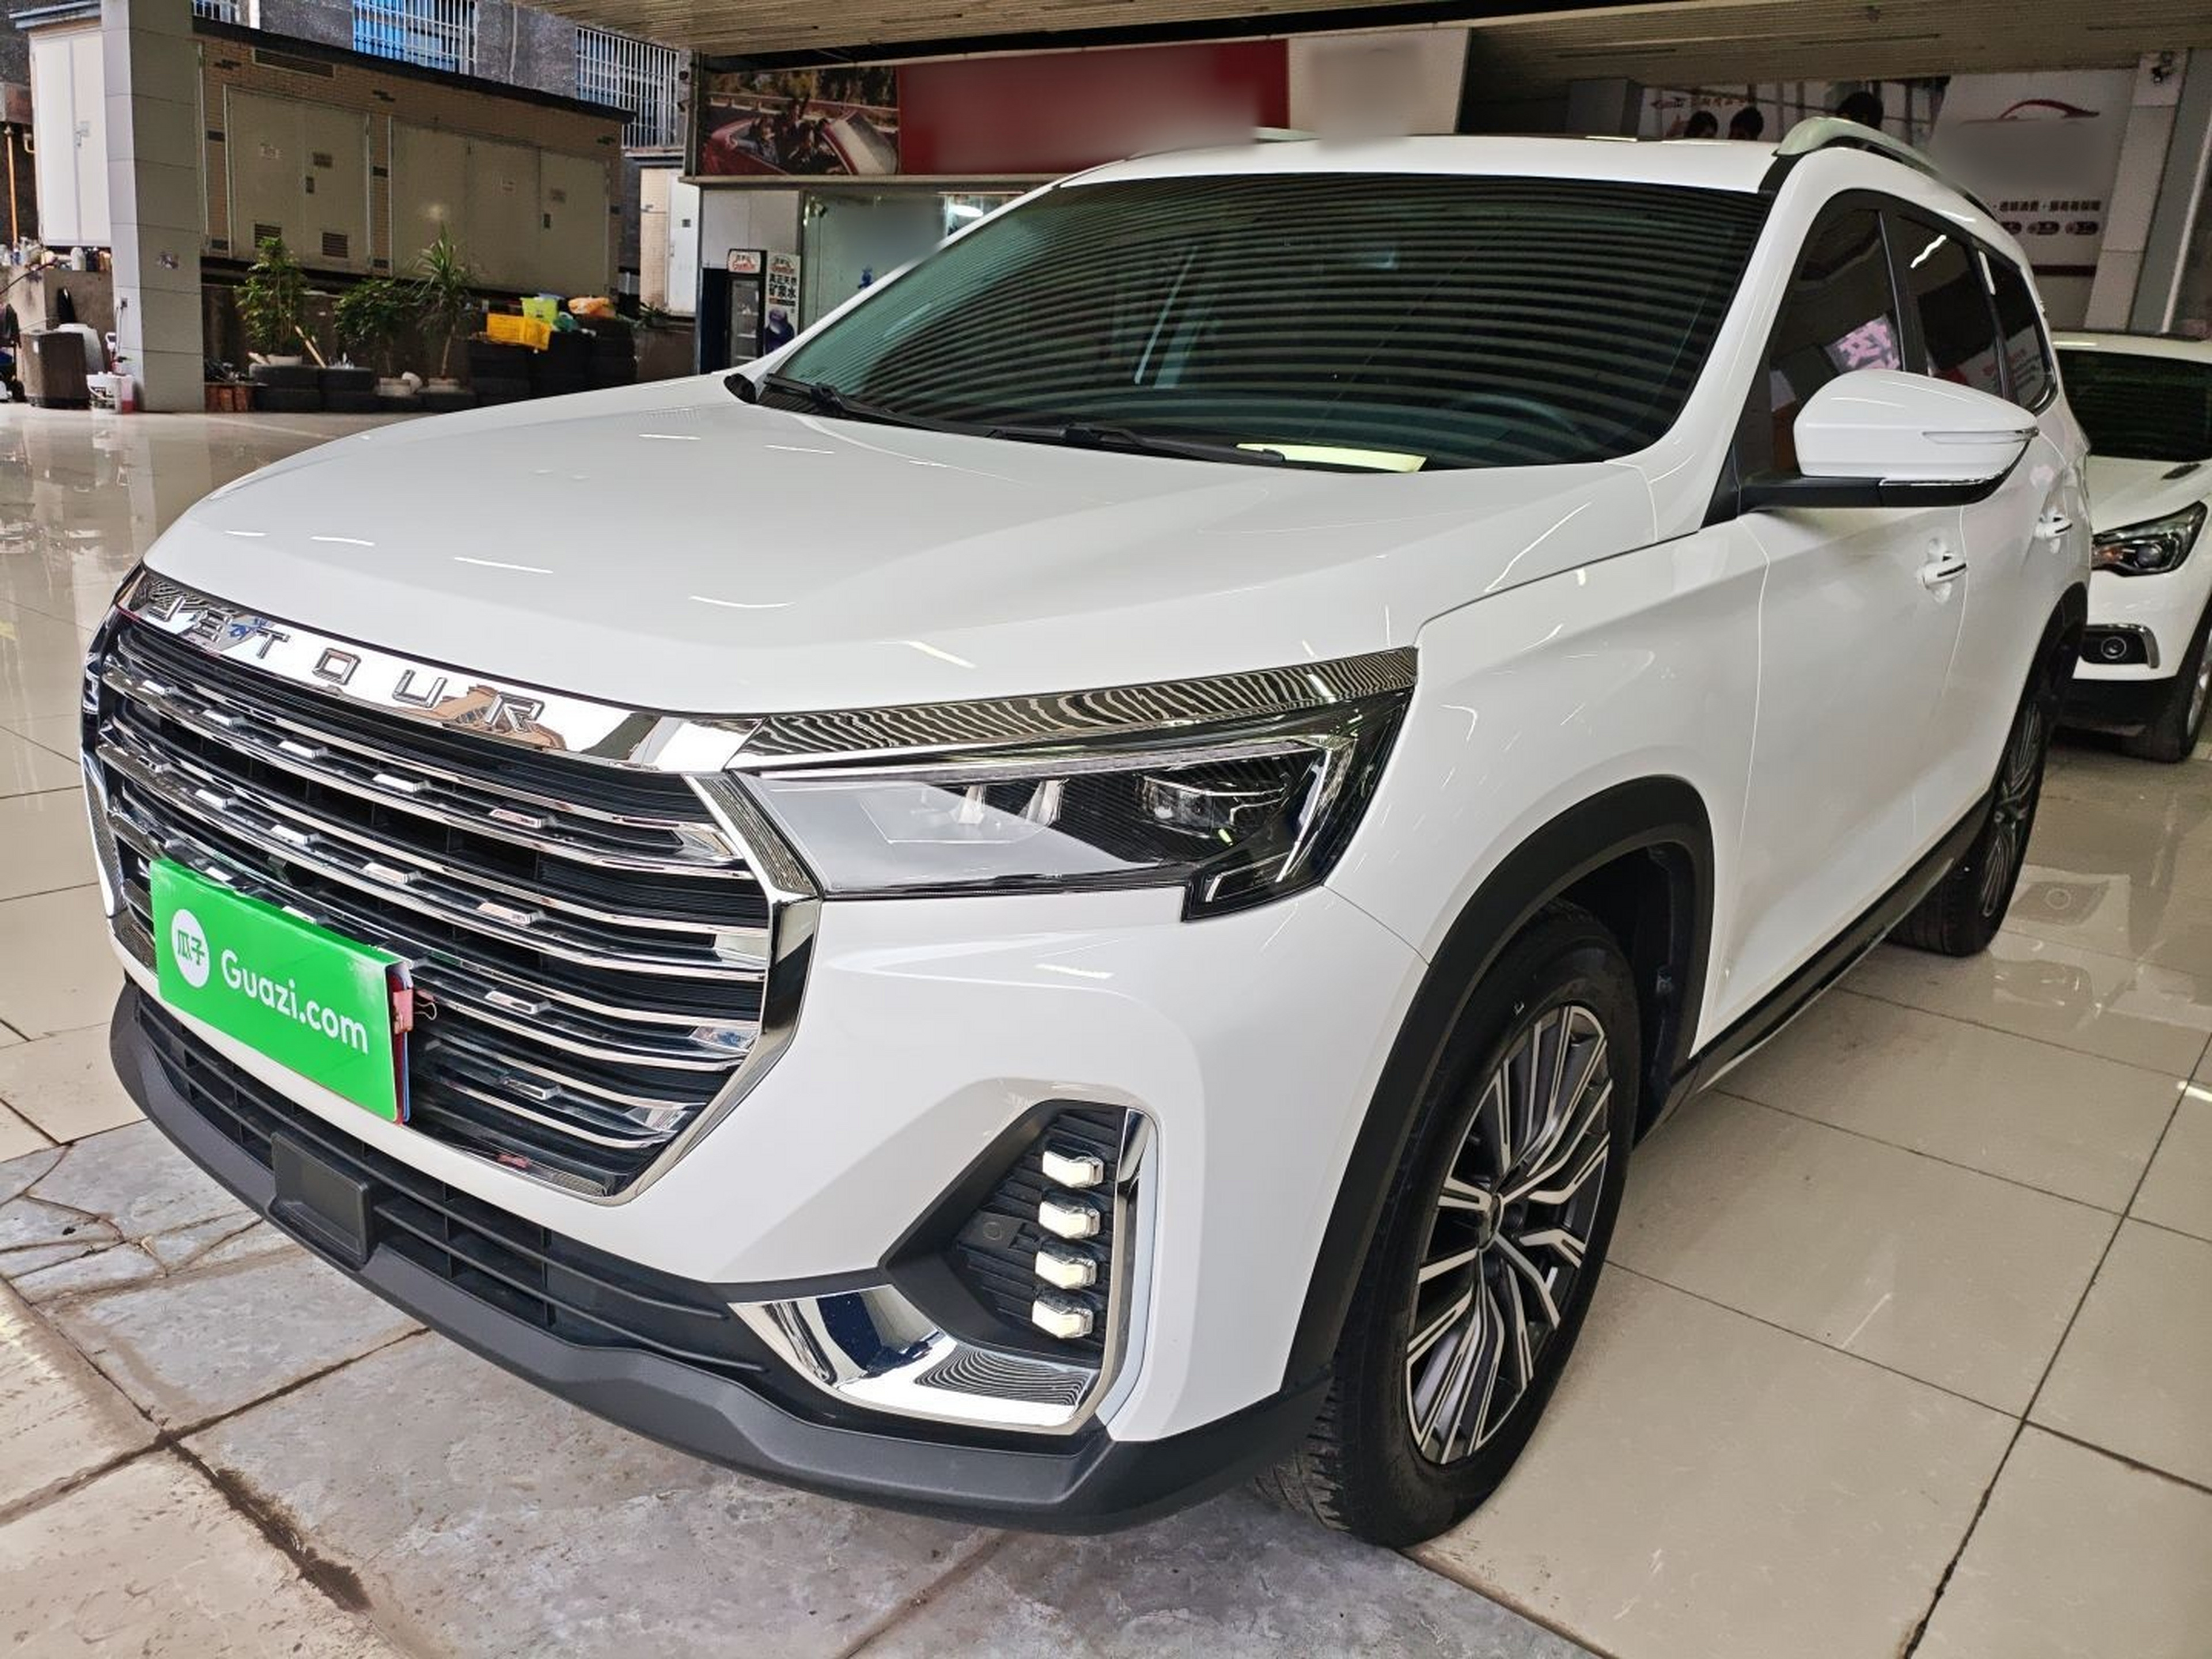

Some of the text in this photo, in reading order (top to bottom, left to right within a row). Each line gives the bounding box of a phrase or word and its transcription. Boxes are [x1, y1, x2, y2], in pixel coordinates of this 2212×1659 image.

[148, 596, 544, 732] JETOUR
[177, 929, 205, 966] 瓜子
[221, 949, 369, 1055] Guazi.com
